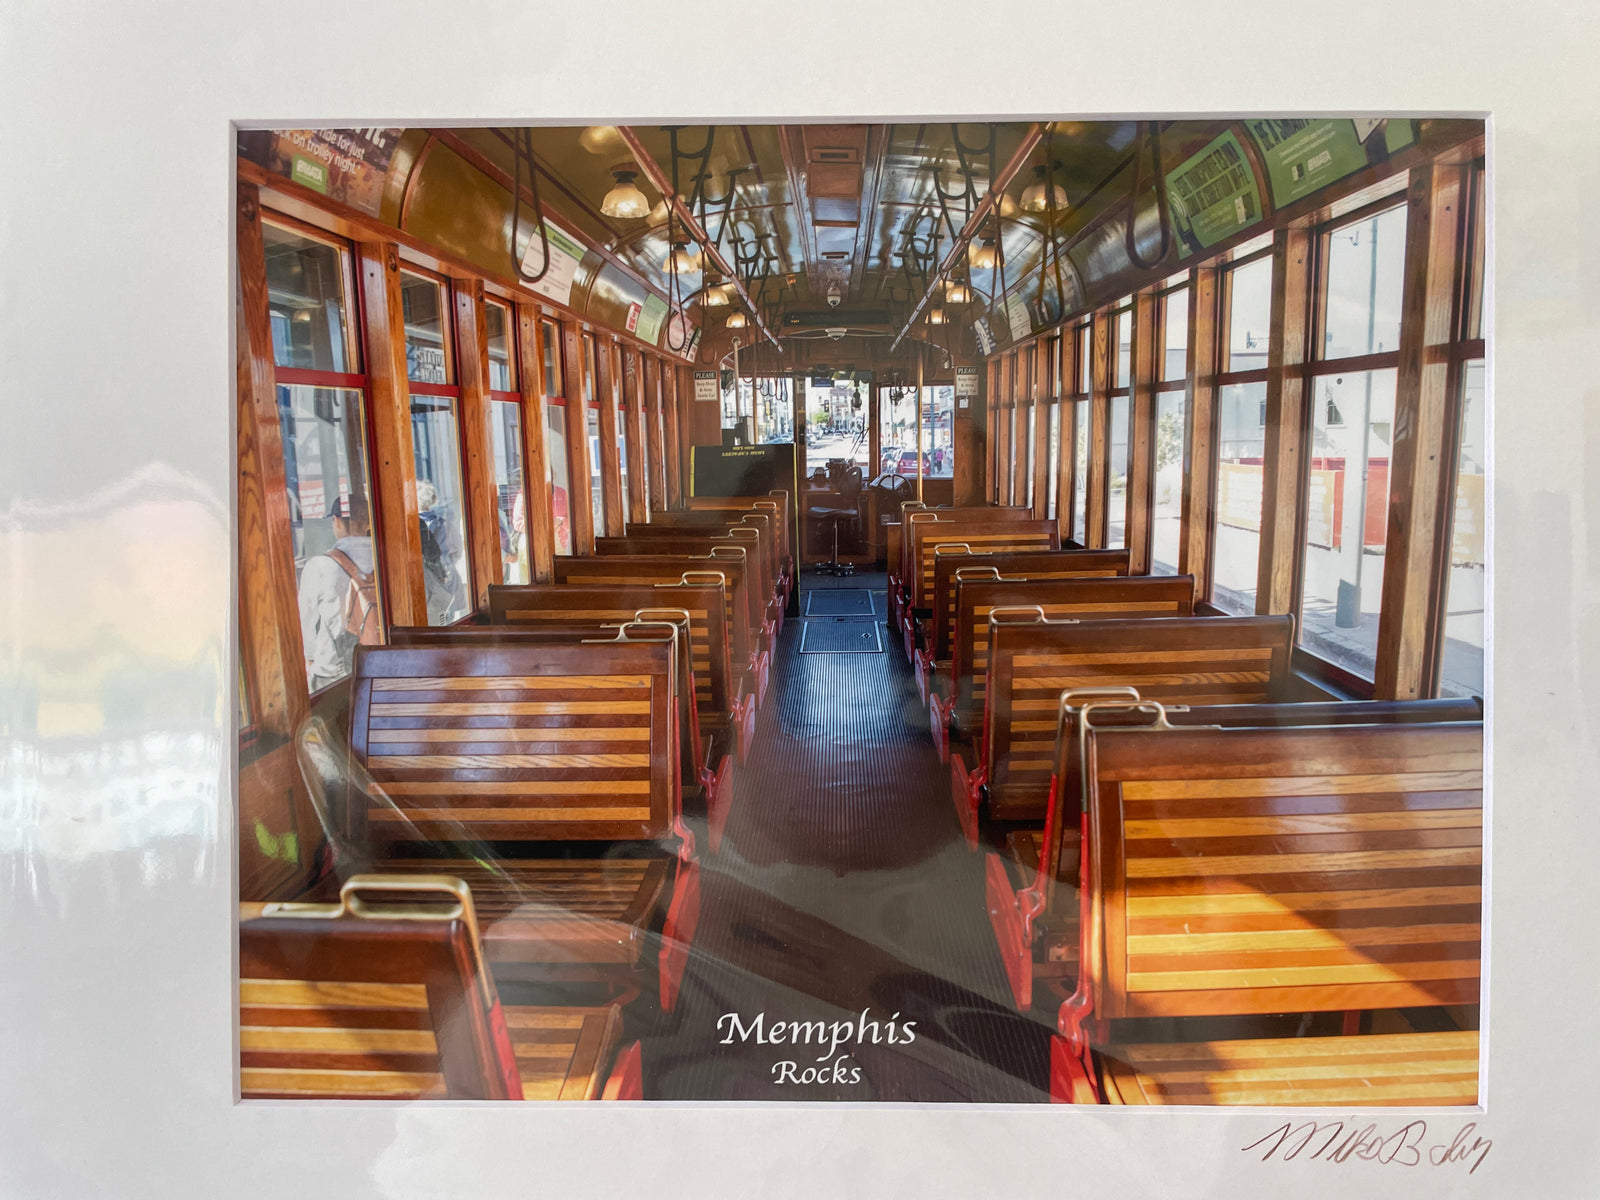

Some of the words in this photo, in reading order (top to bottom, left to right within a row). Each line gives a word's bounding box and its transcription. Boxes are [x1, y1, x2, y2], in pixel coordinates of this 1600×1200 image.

[292, 134, 306, 148] on
[306, 139, 335, 165] trolley
[336, 134, 349, 151] for
[347, 144, 365, 160] just
[716, 1007, 918, 1062] Memphis
[771, 1054, 862, 1085] Rocks
